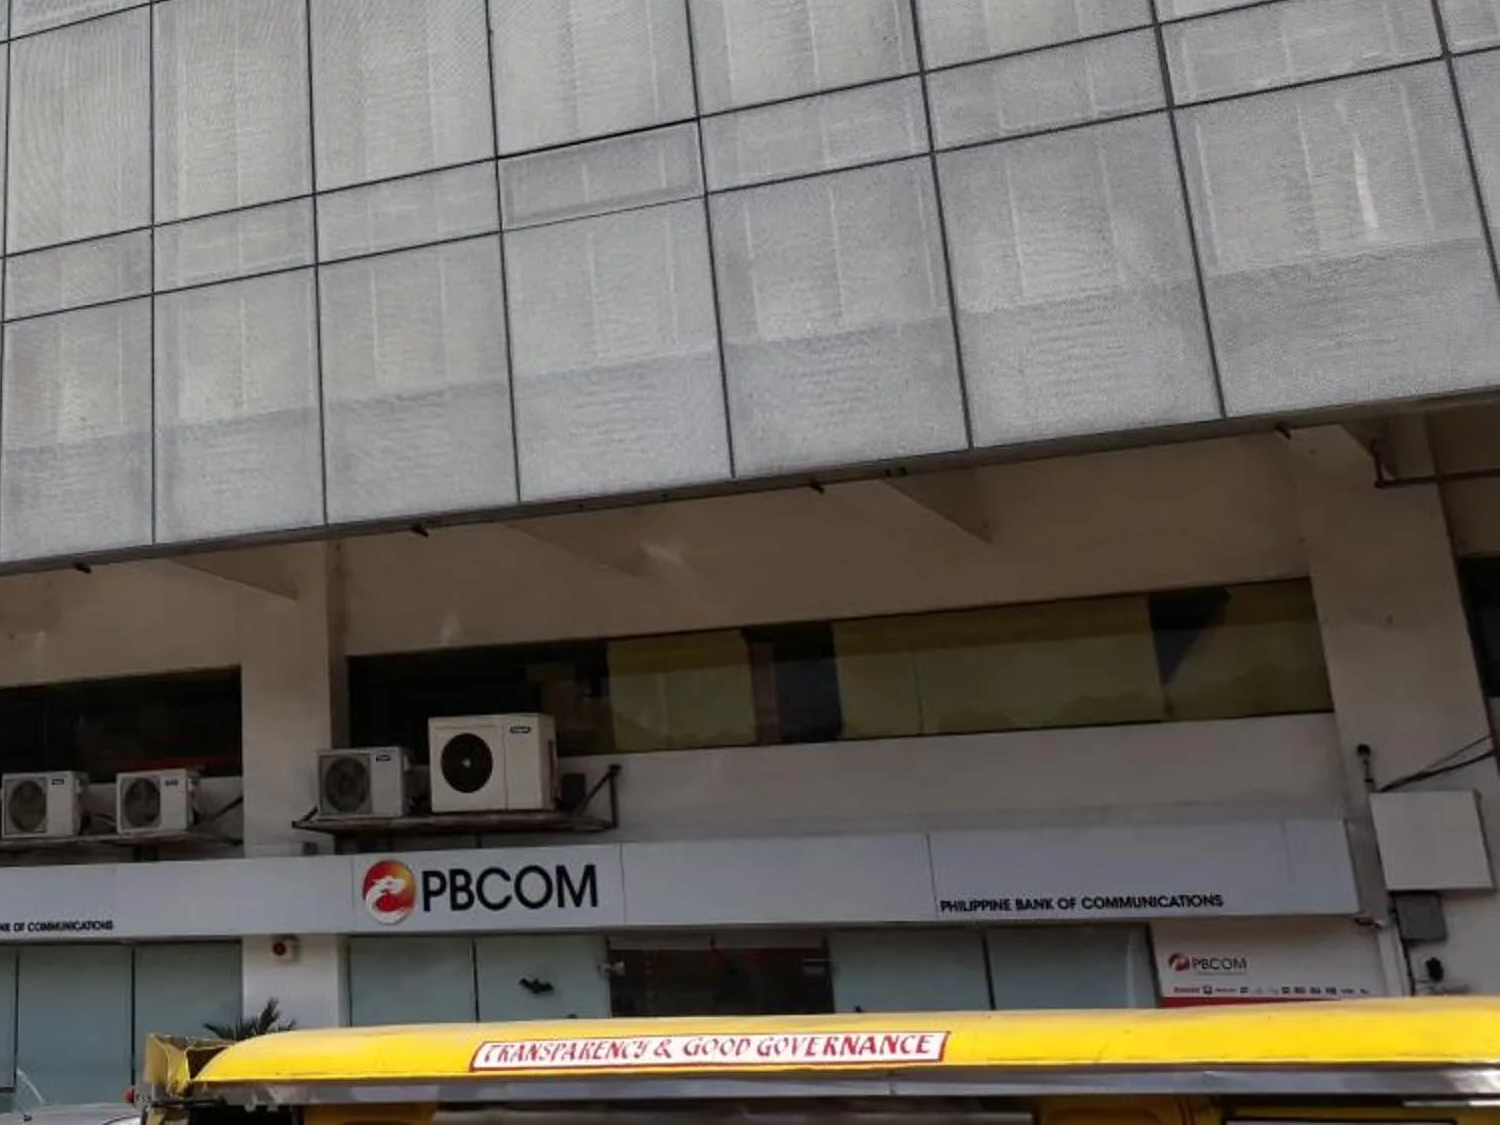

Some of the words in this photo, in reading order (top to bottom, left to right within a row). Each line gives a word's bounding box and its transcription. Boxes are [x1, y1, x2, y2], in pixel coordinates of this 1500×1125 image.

[421, 863, 599, 912] PBCOM
[940, 899, 1012, 912] PHILIPPINE
[1015, 898, 1054, 911] BANK
[1057, 897, 1077, 910] OF
[1080, 893, 1224, 910] COMMUNICATIONS
[13, 921, 26, 932] OF
[27, 919, 114, 932] COMMUNICATIONS
[1191, 956, 1247, 971] PBCOM
[482, 1041, 651, 1064] TRANSPARENCY
[653, 1038, 673, 1059] &
[682, 1036, 750, 1057] GOOD
[756, 1034, 933, 1058] GOVERNANCE
